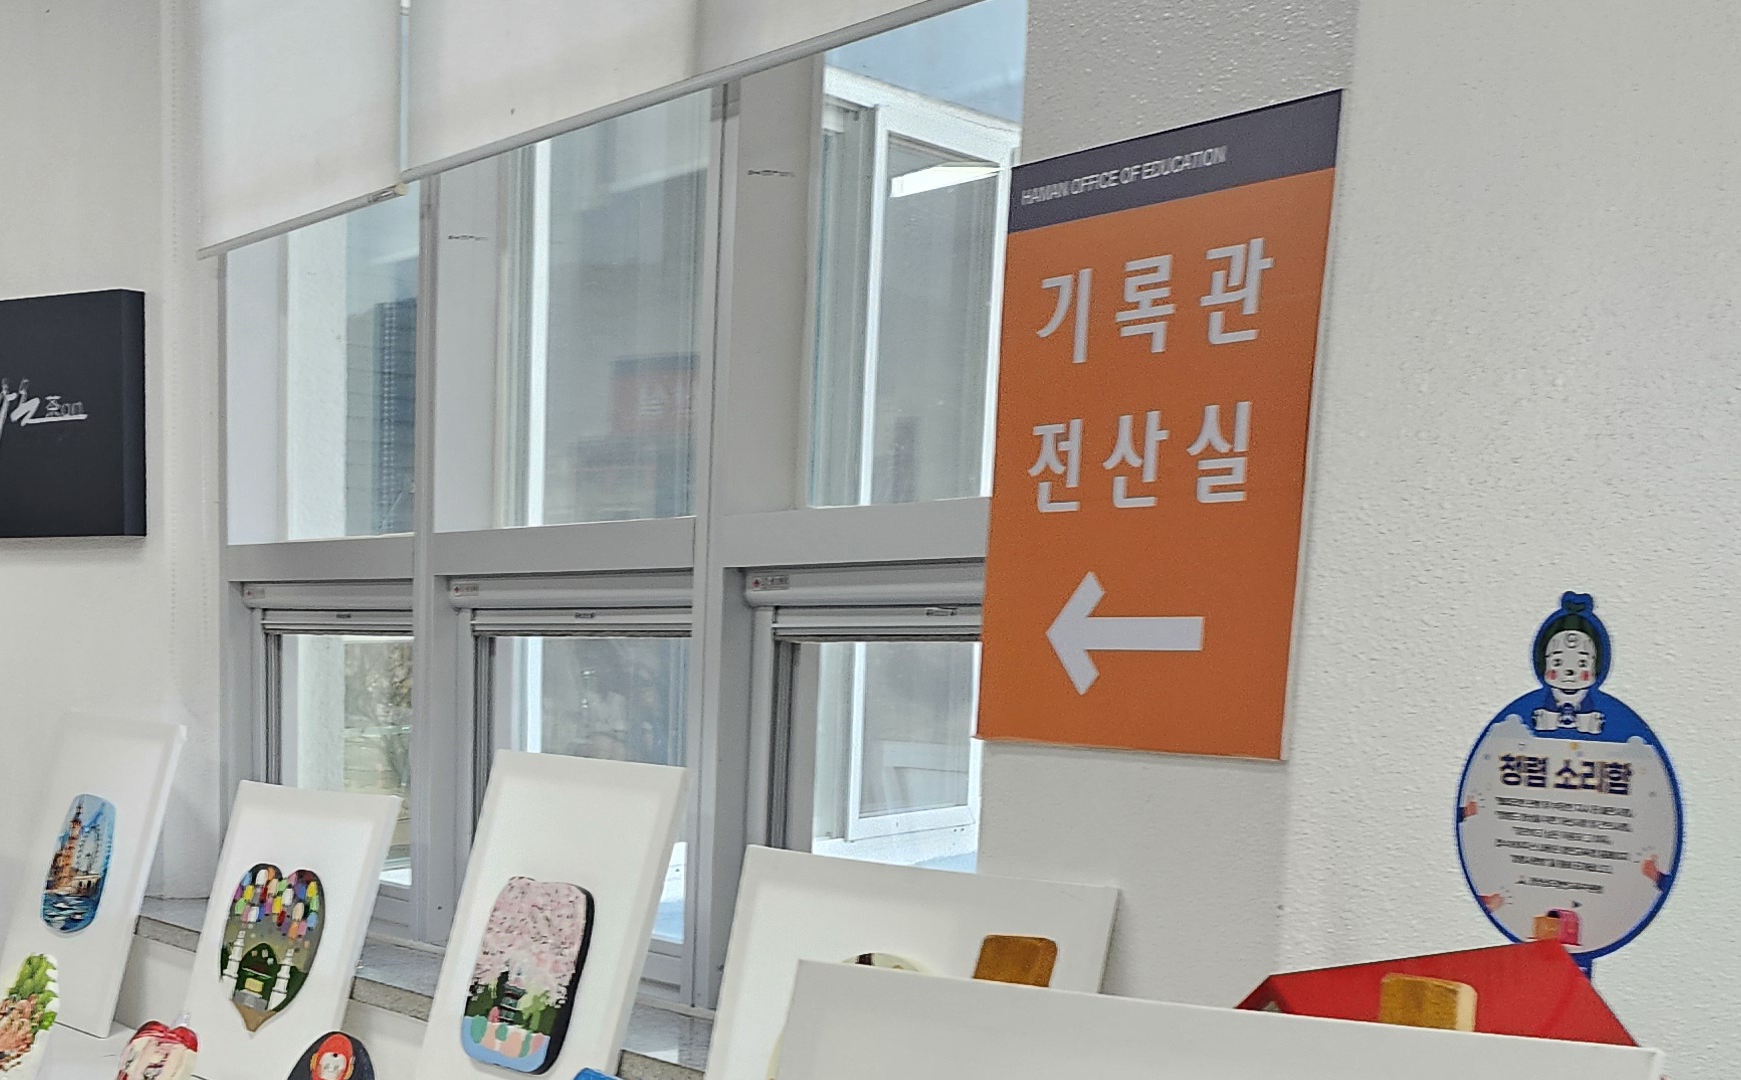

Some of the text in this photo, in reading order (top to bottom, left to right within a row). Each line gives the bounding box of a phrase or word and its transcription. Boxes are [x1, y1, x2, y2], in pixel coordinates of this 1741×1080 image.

[1022, 146, 1228, 205] HAMAN OFFICE OF EDUCATION
[1037, 237, 1275, 364] 기록관
[1027, 400, 1252, 513] 전산실
[1499, 753, 1633, 796] 청렴 소리함
